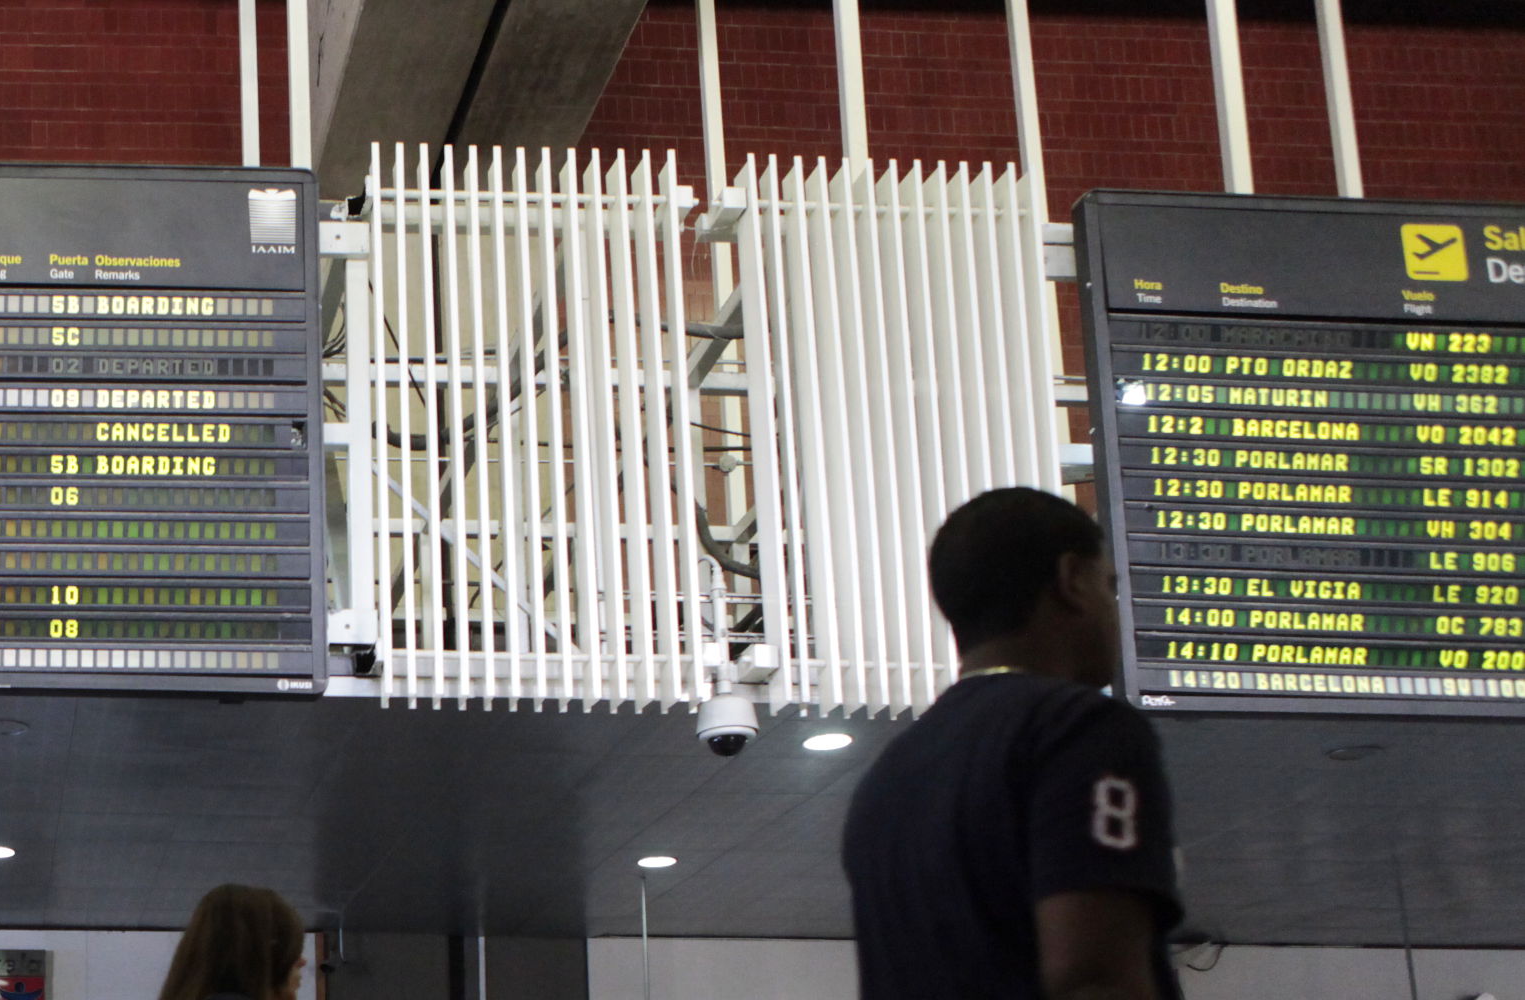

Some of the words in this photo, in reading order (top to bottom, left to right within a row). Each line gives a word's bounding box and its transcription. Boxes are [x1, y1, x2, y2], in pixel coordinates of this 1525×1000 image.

[251, 245, 296, 255] IAAIM
[49, 254, 89, 266] Puerta
[94, 254, 181, 268] Observaciones
[49, 269, 75, 280] Gate
[94, 269, 141, 281] Remarks
[1134, 279, 1163, 291] Hora
[1219, 282, 1264, 296] Destino
[51, 295, 80, 315] 5B
[96, 296, 215, 316] BOARDING
[1136, 293, 1163, 305] Time
[1222, 297, 1278, 310] Destination
[51, 327, 80, 346] 5C
[1447, 332, 1492, 353] 223
[52, 358, 80, 374] 02
[97, 358, 215, 376] DEPARTED
[1141, 353, 1212, 373] 12:00
[1225, 356, 1269, 376] PTO
[1282, 359, 1353, 379] ORDAZ
[1409, 363, 1438, 382] VO
[1451, 364, 1509, 384] 2382
[96, 389, 216, 410] DEPARTED
[1229, 387, 1329, 409] MATURIN
[1455, 394, 1499, 414] 362
[96, 422, 231, 443] CANCELLED
[1231, 418, 1360, 441] BARCELONA
[1416, 424, 1445, 444] VO
[1458, 425, 1516, 446] 2042
[50, 454, 79, 474] 5B
[96, 455, 216, 475] BOARDING
[1151, 446, 1221, 467] 12:30
[1234, 449, 1349, 471] PORLAMAR
[1463, 457, 1521, 478] 1302
[50, 486, 79, 506] 06
[1153, 478, 1224, 499] 12:30
[1237, 480, 1352, 503] PORLAMAR
[1422, 487, 1453, 508] LE
[1465, 488, 1509, 509] 914
[1156, 510, 1227, 531] 12:30
[1240, 512, 1355, 535] PORLAMAR
[1426, 519, 1455, 538] VH
[1469, 520, 1512, 540] 304
[1429, 551, 1458, 571] LE
[1472, 552, 1516, 572] 906
[50, 585, 79, 605] 10
[1161, 575, 1232, 596] 13:30
[1246, 578, 1275, 598] EL
[1290, 580, 1361, 601] VIGIA
[1432, 585, 1462, 603] LE
[1475, 585, 1520, 605] 920
[49, 619, 79, 638] 08
[1164, 607, 1235, 628] 14:00
[1249, 610, 1365, 632] PORLAMAR
[1435, 616, 1465, 635] OC
[1478, 617, 1523, 637] 783
[1167, 640, 1238, 661] 14:10
[1252, 643, 1368, 667] PORLAMAR
[1439, 649, 1469, 669] VO
[1169, 670, 1240, 689] 14:20
[1255, 673, 1385, 694] BARCELONA
[1092, 775, 1139, 851] 8
